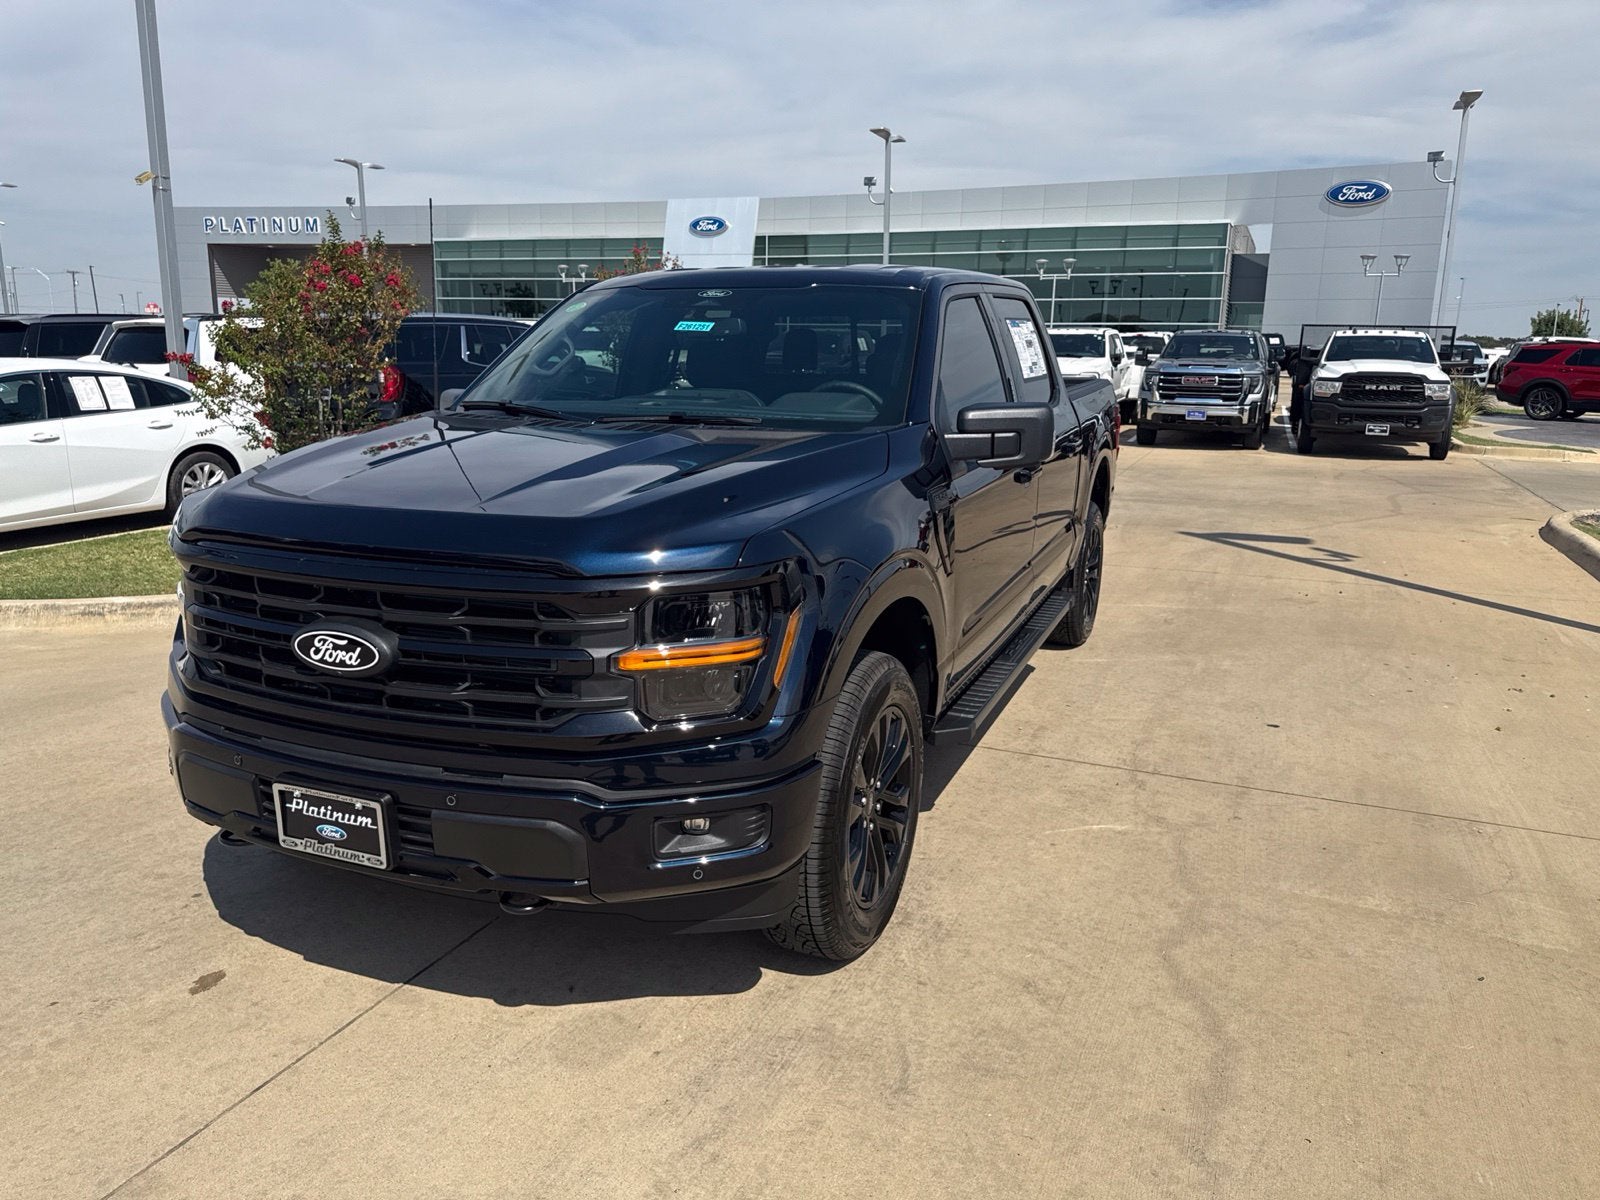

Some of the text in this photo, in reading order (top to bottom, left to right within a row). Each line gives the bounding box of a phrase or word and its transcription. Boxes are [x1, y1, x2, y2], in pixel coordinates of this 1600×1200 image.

[1338, 185, 1377, 201] Ford
[204, 217, 320, 233] PLATINUM
[696, 220, 719, 231] Ford
[310, 635, 361, 666] Ford
[285, 797, 378, 829] Platinum
[303, 839, 365, 863] Platinum
